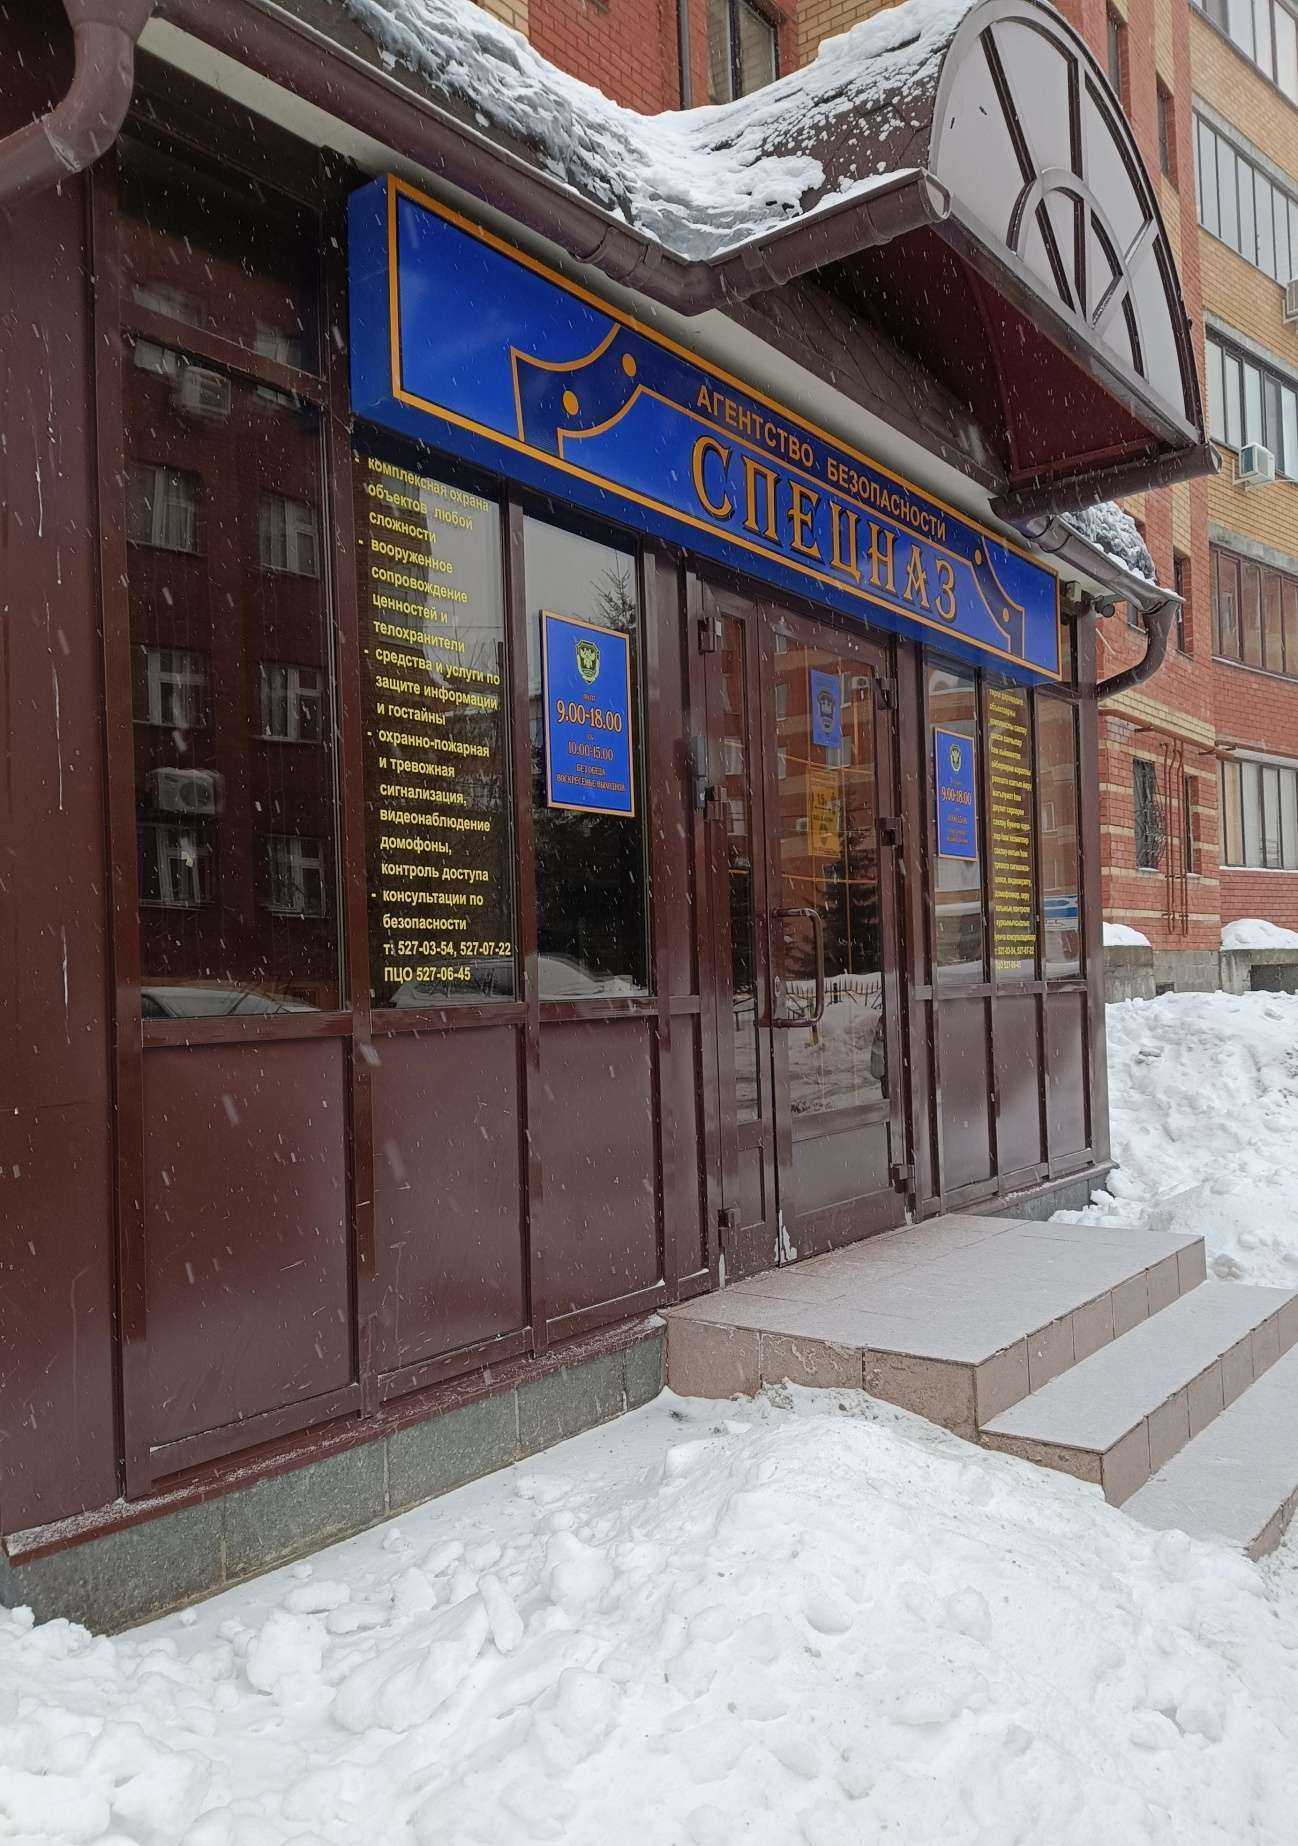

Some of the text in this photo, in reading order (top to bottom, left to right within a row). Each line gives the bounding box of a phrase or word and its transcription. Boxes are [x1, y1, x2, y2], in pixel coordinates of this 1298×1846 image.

[697, 384, 947, 542] АГЕНТСТВО БЕЗОПАСНОСТИ
[368, 457, 489, 512] комплексная охрана
[368, 484, 473, 530] объектов любой
[369, 511, 436, 543] сложности
[692, 435, 957, 620] СПЕЦНАЗ
[371, 539, 453, 574] вооруженное
[371, 566, 468, 603] сопровождение
[373, 593, 448, 624] ценностей и
[373, 620, 465, 653] телохранители
[375, 648, 500, 685] средства и услуги по
[375, 675, 498, 711] защите информации
[377, 703, 446, 726] и гостайны
[556, 700, 623, 735] 9.00-18.00
[378, 730, 490, 758] охранно-пожарная
[379, 757, 455, 777] и тревожная
[379, 783, 467, 806] сигнализация,
[380, 809, 491, 832] видеонаблюдение
[380, 835, 452, 856] домофоны,
[381, 863, 489, 884] контроль доступа
[383, 889, 484, 906] консультации по
[383, 914, 467, 931] безопасности
[398, 940, 457, 957] 527-03-54,
[460, 942, 511, 956] 527-07-22
[384, 966, 471, 984] ПЦО 527-06-45
